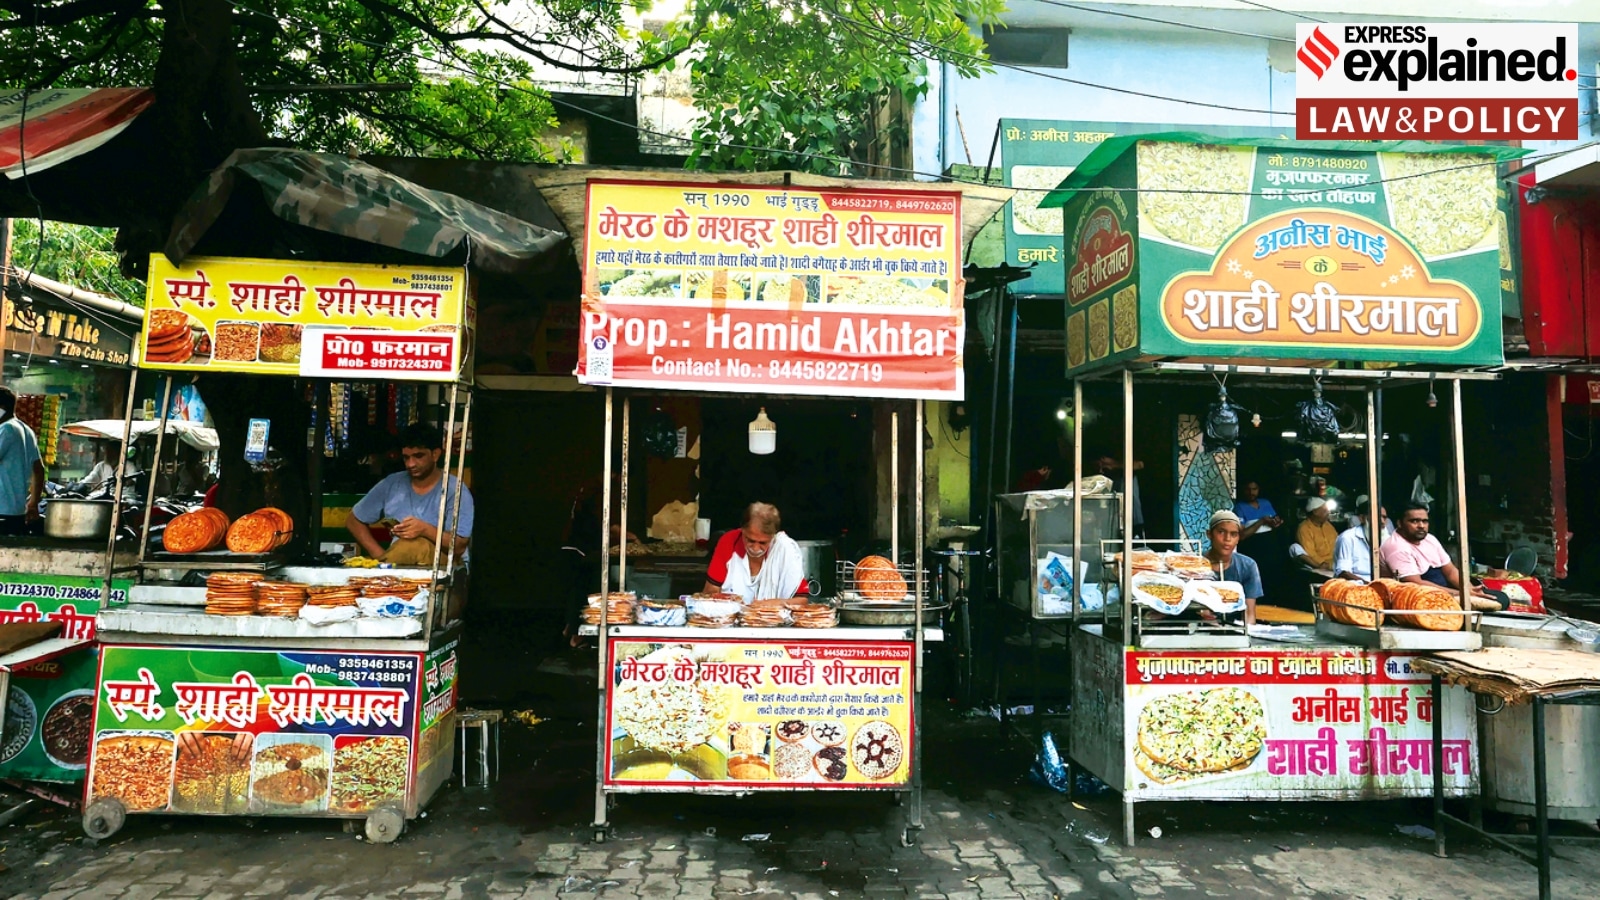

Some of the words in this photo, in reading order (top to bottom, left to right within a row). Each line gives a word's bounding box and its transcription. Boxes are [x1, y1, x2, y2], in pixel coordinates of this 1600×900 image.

[1030, 128, 1069, 142] अनीस
[1292, 157, 1368, 170] 8791480920
[714, 194, 750, 206] 1990
[766, 192, 787, 207] भाई
[831, 198, 892, 210] 8445822719,
[896, 200, 953, 211] 8449762620
[599, 207, 656, 238] मेरठ
[664, 209, 689, 238] के
[698, 217, 774, 248] मशहूर
[783, 213, 838, 245] शाही
[847, 214, 943, 247] शीरमाल
[1255, 219, 1330, 257] अनीस
[1337, 226, 1388, 262] भाई
[654, 251, 661, 264] के
[791, 254, 810, 268] शादी
[840, 257, 847, 269] के
[873, 257, 882, 271] भी
[1018, 245, 1059, 262] हमारे
[1091, 243, 1128, 287] शीरमाल
[1313, 259, 1328, 273] के
[229, 275, 306, 316] शाही
[315, 278, 442, 318] शीरमाल
[1183, 280, 1280, 332] शाही
[1291, 282, 1460, 336] शीरमाल
[706, 314, 820, 352] Hamid
[834, 319, 949, 356] Akhtar
[60, 340, 81, 357] The
[84, 346, 105, 361] Cake
[371, 341, 450, 357] फरमान
[337, 358, 368, 368] Mob-
[370, 359, 442, 369] 9917324370
[651, 356, 720, 377] Contact
[727, 359, 763, 378] No.:
[768, 361, 883, 382] 8445822719
[306, 663, 336, 674] Mob-
[339, 658, 413, 669] 9359461354
[622, 657, 668, 682] मेरठ
[674, 658, 695, 681] के
[701, 664, 764, 688] मशहूर
[771, 660, 815, 685] शाही
[822, 660, 901, 685] शीरमाल
[1250, 657, 1274, 675] का
[338, 671, 411, 682] 9837438801
[176, 673, 259, 722] शाही
[268, 675, 406, 726] शीरमाल
[1292, 688, 1361, 722] अनीस
[1369, 688, 1409, 724] भाई
[1265, 727, 1338, 776] शाही
[1347, 727, 1471, 776] शीरमल
